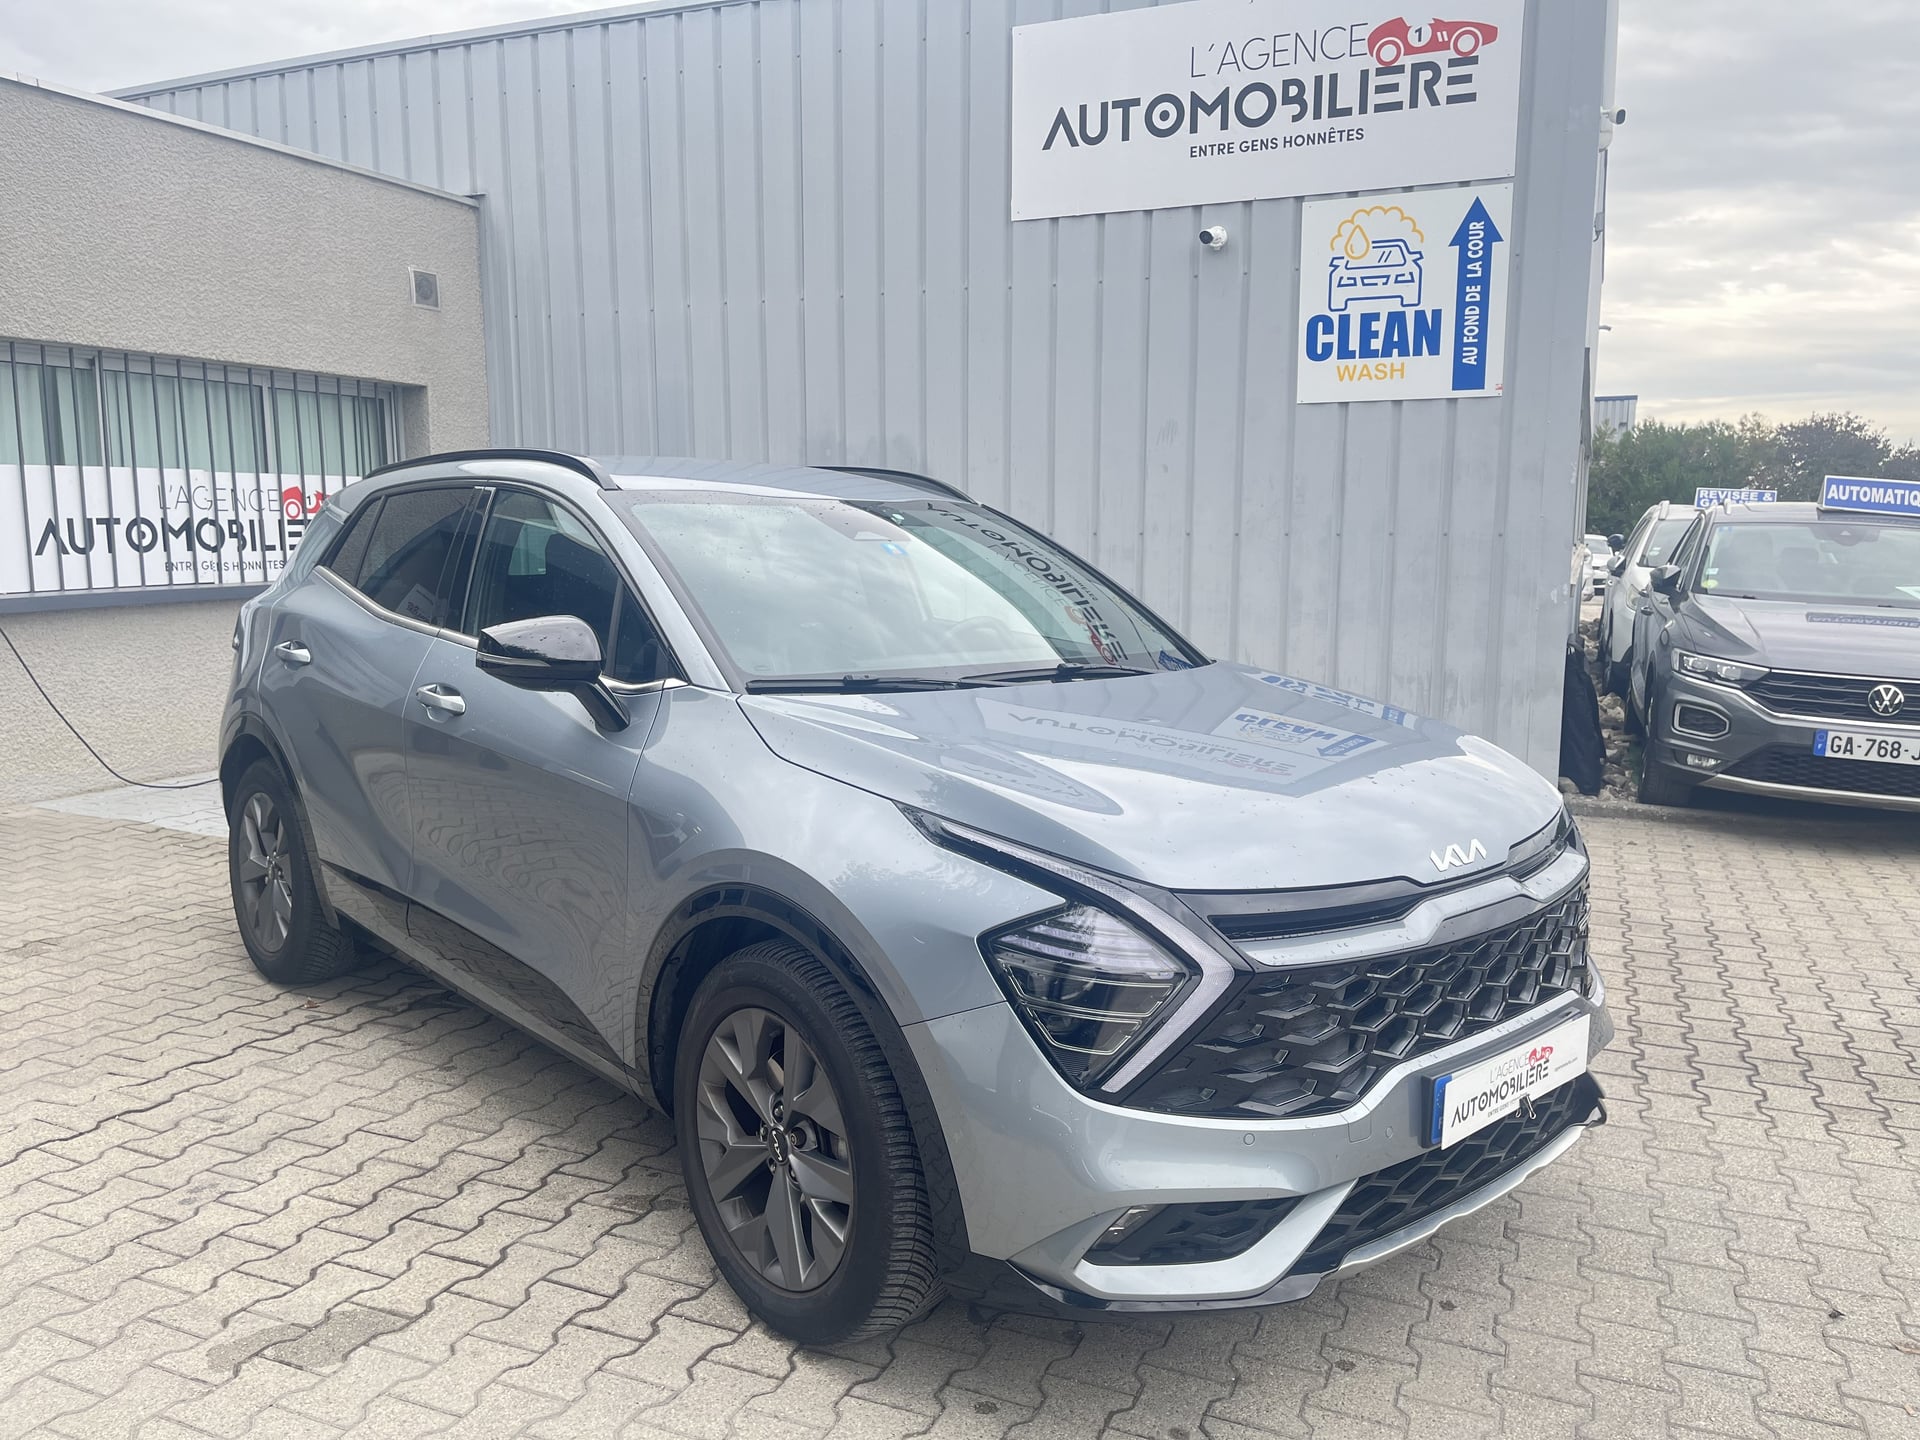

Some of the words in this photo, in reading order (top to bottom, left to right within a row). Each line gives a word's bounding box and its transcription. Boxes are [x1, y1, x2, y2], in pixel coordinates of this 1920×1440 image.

[1189, 22, 1369, 79] L'AGENCE
[1189, 142, 1235, 158] ENTRE
[1239, 137, 1279, 153] GENS
[1283, 127, 1365, 149] HONNÊTES
[1468, 220, 1485, 259] COUR
[1467, 261, 1482, 278] LA
[1465, 284, 1481, 302] DE
[1306, 308, 1442, 362] CLEAN
[1463, 305, 1480, 342] FOND
[1462, 346, 1478, 365] AU
[1336, 362, 1405, 382] WASH
[157, 484, 280, 512] L'AGENCE
[35, 516, 311, 556] AUTOMOBILIE
[165, 561, 194, 572] ENTR
[201, 560, 229, 572] GES
[232, 560, 285, 572] HONNTES
[1430, 838, 1487, 872] KIA
[1489, 1052, 1529, 1084] L'AGENCE
